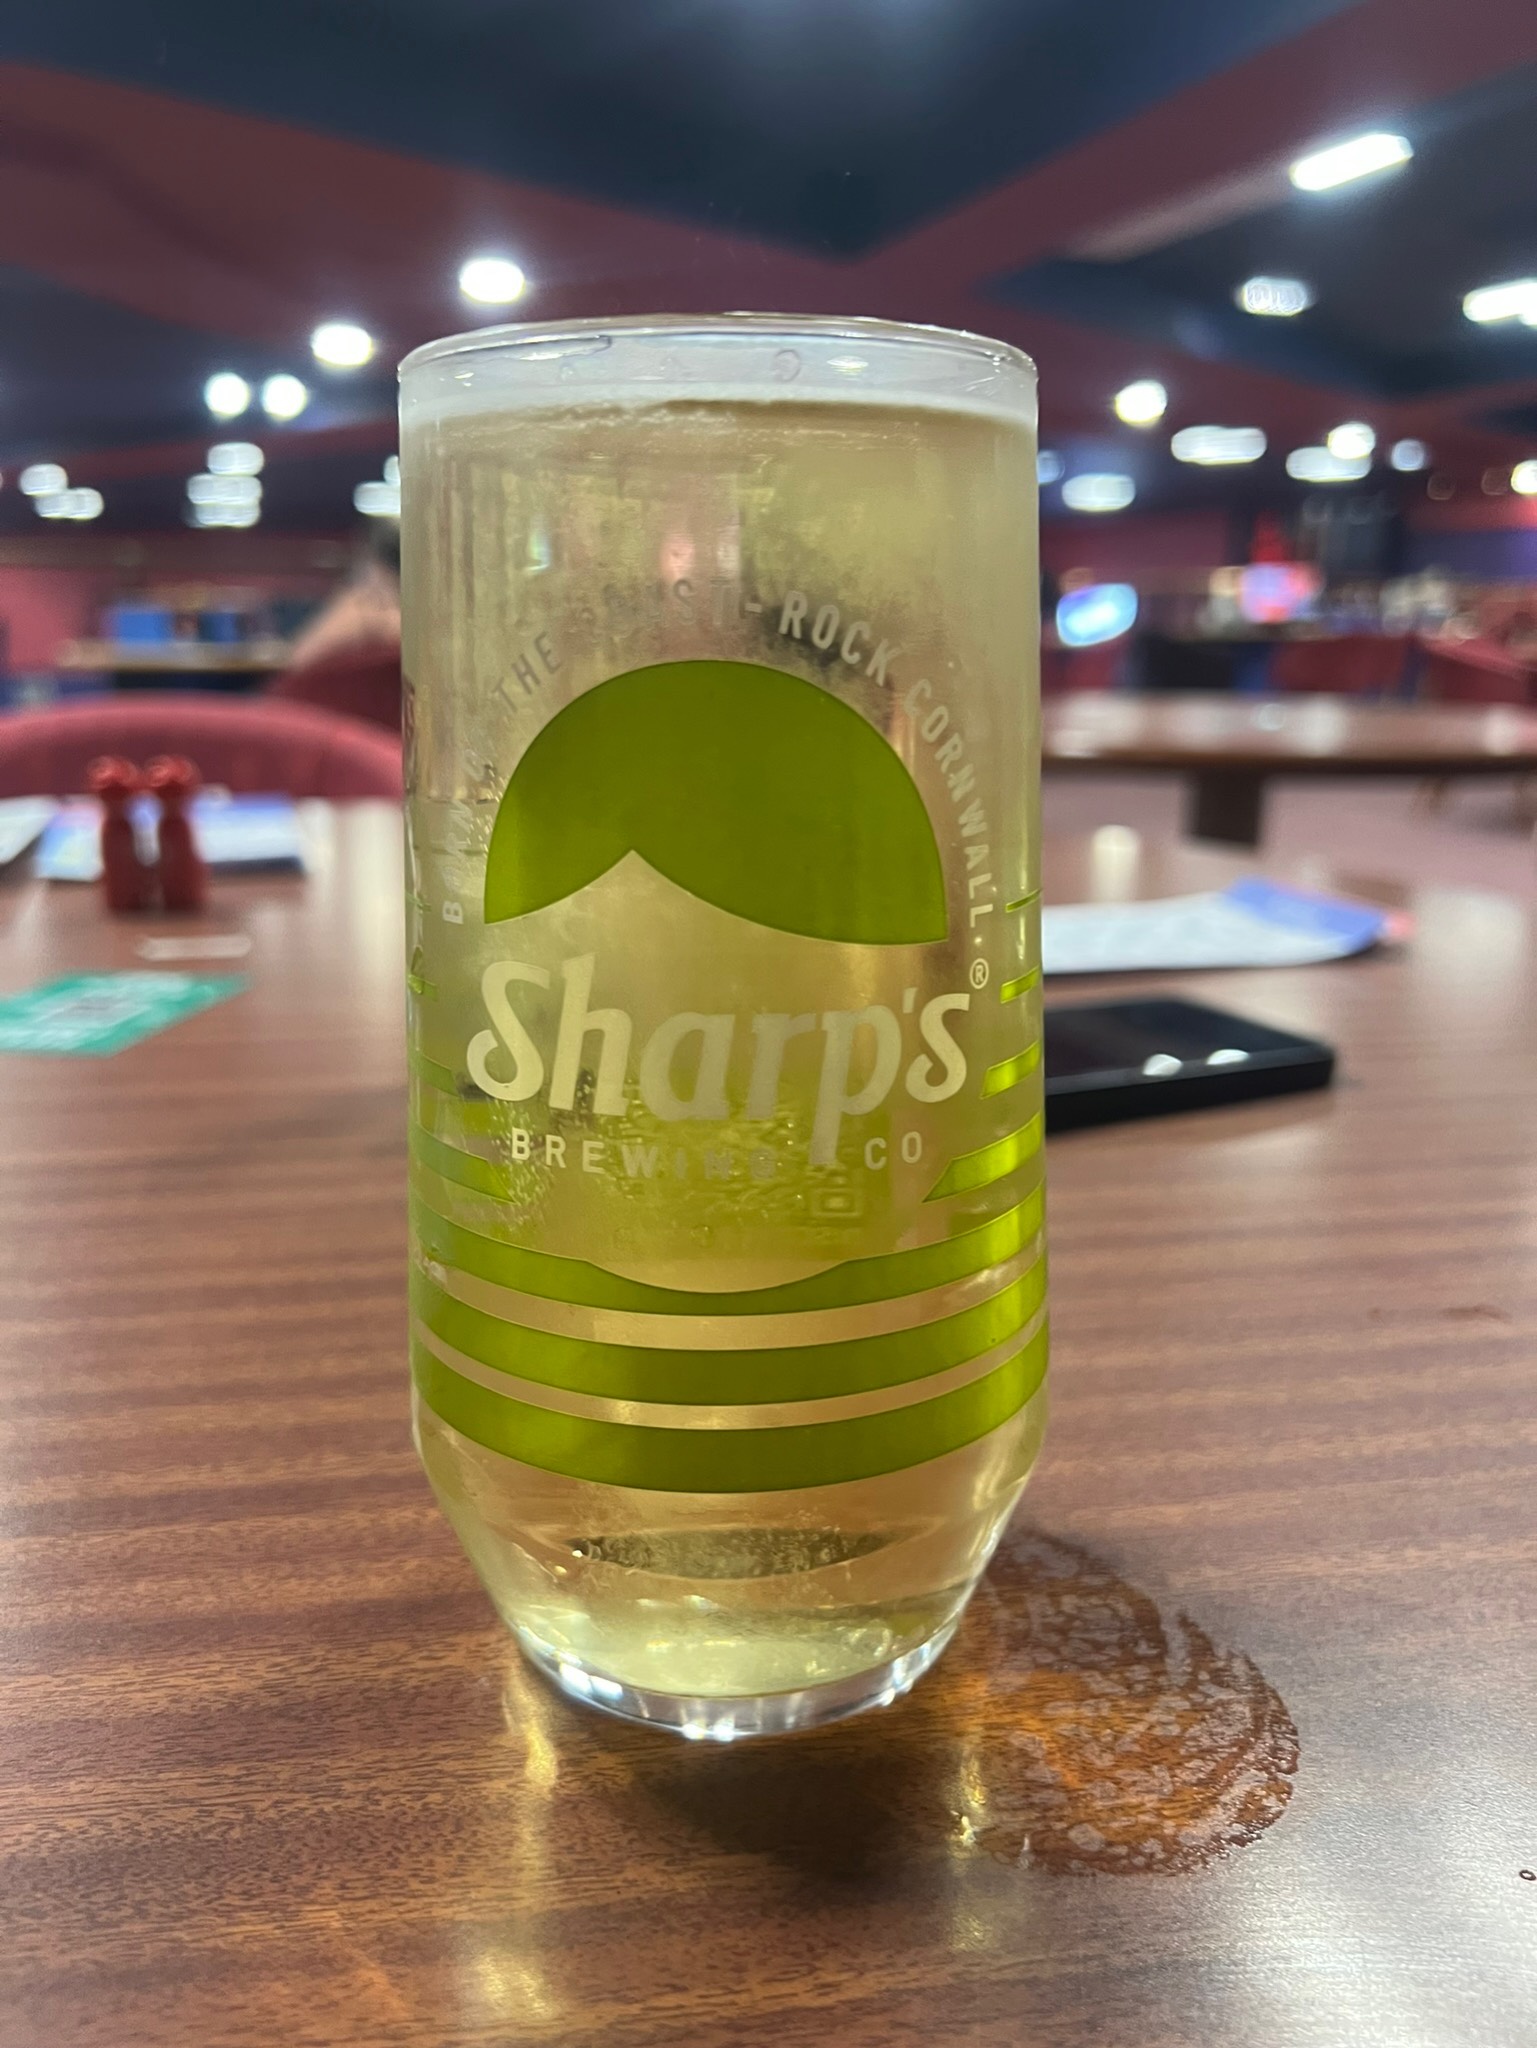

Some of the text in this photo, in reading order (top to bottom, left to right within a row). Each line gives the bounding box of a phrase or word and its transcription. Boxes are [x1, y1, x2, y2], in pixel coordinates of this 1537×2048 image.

[491, 631, 562, 713] THE
[779, 590, 898, 687] ROCK
[466, 953, 970, 1165] Sharp's
[864, 1131, 923, 1170] CO
